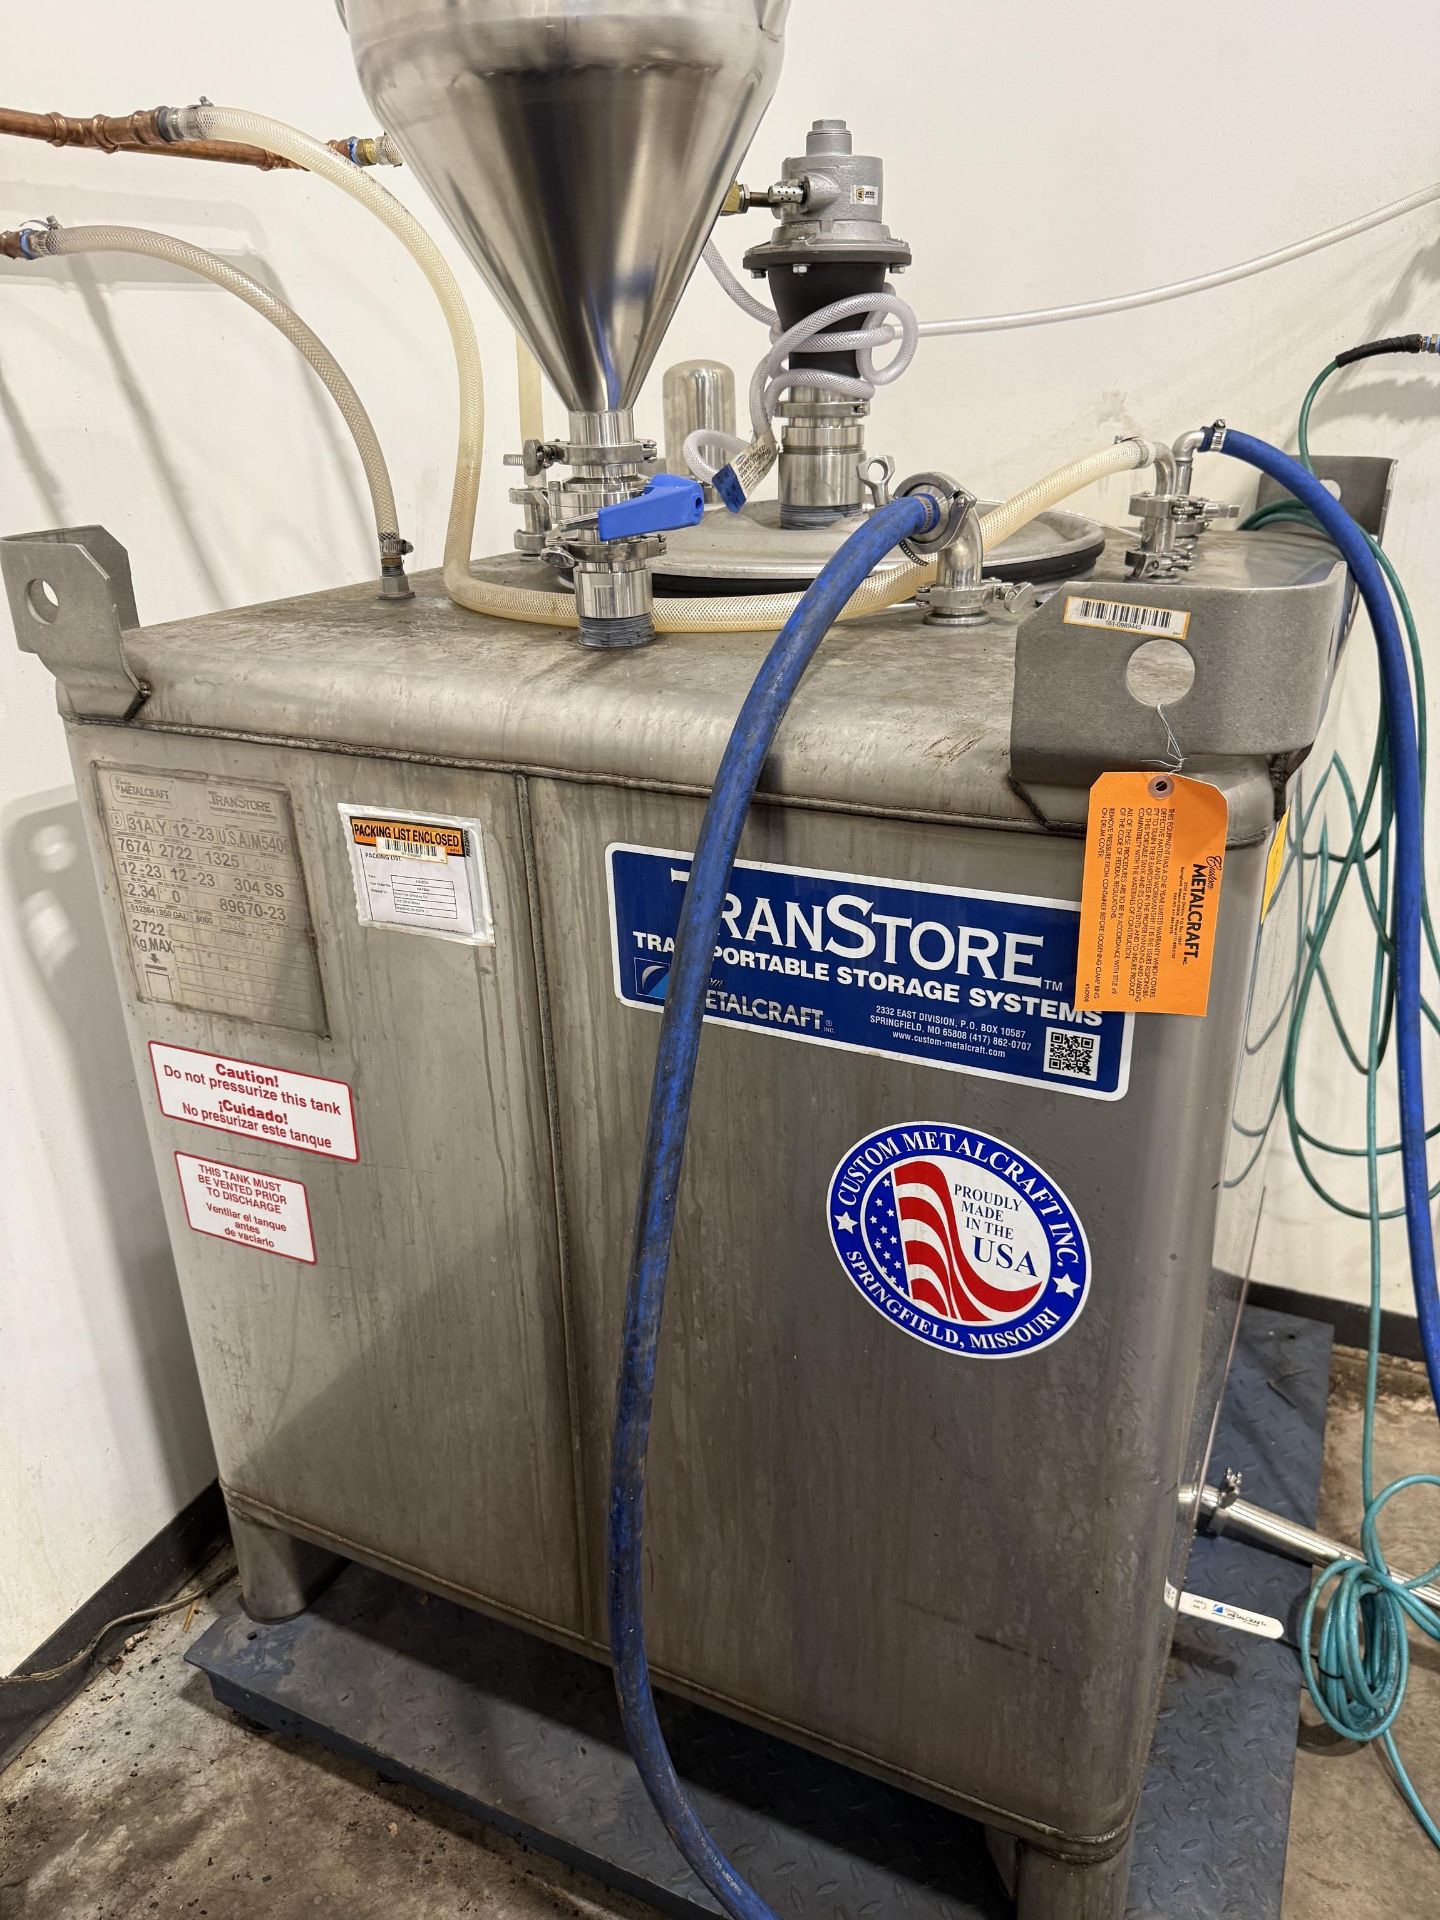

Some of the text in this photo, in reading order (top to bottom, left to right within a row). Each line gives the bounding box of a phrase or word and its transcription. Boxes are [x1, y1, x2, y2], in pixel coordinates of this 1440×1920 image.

[129, 818, 153, 833] 31A
[157, 821, 166, 835] Y
[174, 824, 214, 841] 12-23
[355, 825, 391, 838] PACKING
[394, 828, 410, 841] LIST
[413, 831, 458, 846] ENCLOSED
[1159, 808, 1167, 837] DEFECTIVE
[1165, 822, 1173, 854] EQUIPMENT
[118, 838, 150, 854] 7674
[160, 844, 193, 860] 2722
[206, 852, 239, 868] 1325
[1146, 862, 1154, 893] EMPLOYEES
[1206, 856, 1222, 890] Custom
[128, 883, 156, 899] 2.34
[220, 899, 286, 922] 89670-23
[234, 878, 260, 893] 304
[265, 883, 284, 898] SS
[1185, 865, 1206, 957] METALCRAFT
[133, 920, 165, 936] 2722
[707, 991, 822, 1028] ETALCRAFT
[838, 968, 959, 1002] STORAGE
[971, 989, 1101, 1025] SYSTEMS
[871, 1016, 1031, 1050] SPRINGFIELD, MO 65808 (417) 862-0707
[877, 1006, 1025, 1038] 2332 EAST DIVISION, P.O. BOX 10587
[894, 1033, 1005, 1057] www.custom-metalcraft.com
[164, 1065, 340, 1115] Do not pressurize this tank
[216, 1064, 278, 1087] Caution!
[183, 1103, 331, 1148] No presurizar este tanque
[219, 1100, 287, 1124] ¡Cuidado!
[198, 1175, 286, 1204] BE VENTED PRIOR
[199, 1164, 280, 1192] THIS TANK MUST
[207, 1187, 280, 1213] TO DISCHARGE
[837, 1130, 1079, 1267] CUSTOM METALCRAFT INC.
[953, 1183, 1023, 1212] PROUDLY
[961, 1200, 1004, 1222] MADE
[207, 1203, 286, 1231] Ventilar el tanque
[235, 1222, 260, 1234] antes
[966, 1217, 1014, 1240] IN THE
[225, 1228, 274, 1247] de vaciarlo
[972, 1235, 1039, 1277] USA
[845, 1250, 1062, 1350] SPRINGFIELD, MISSOURI
